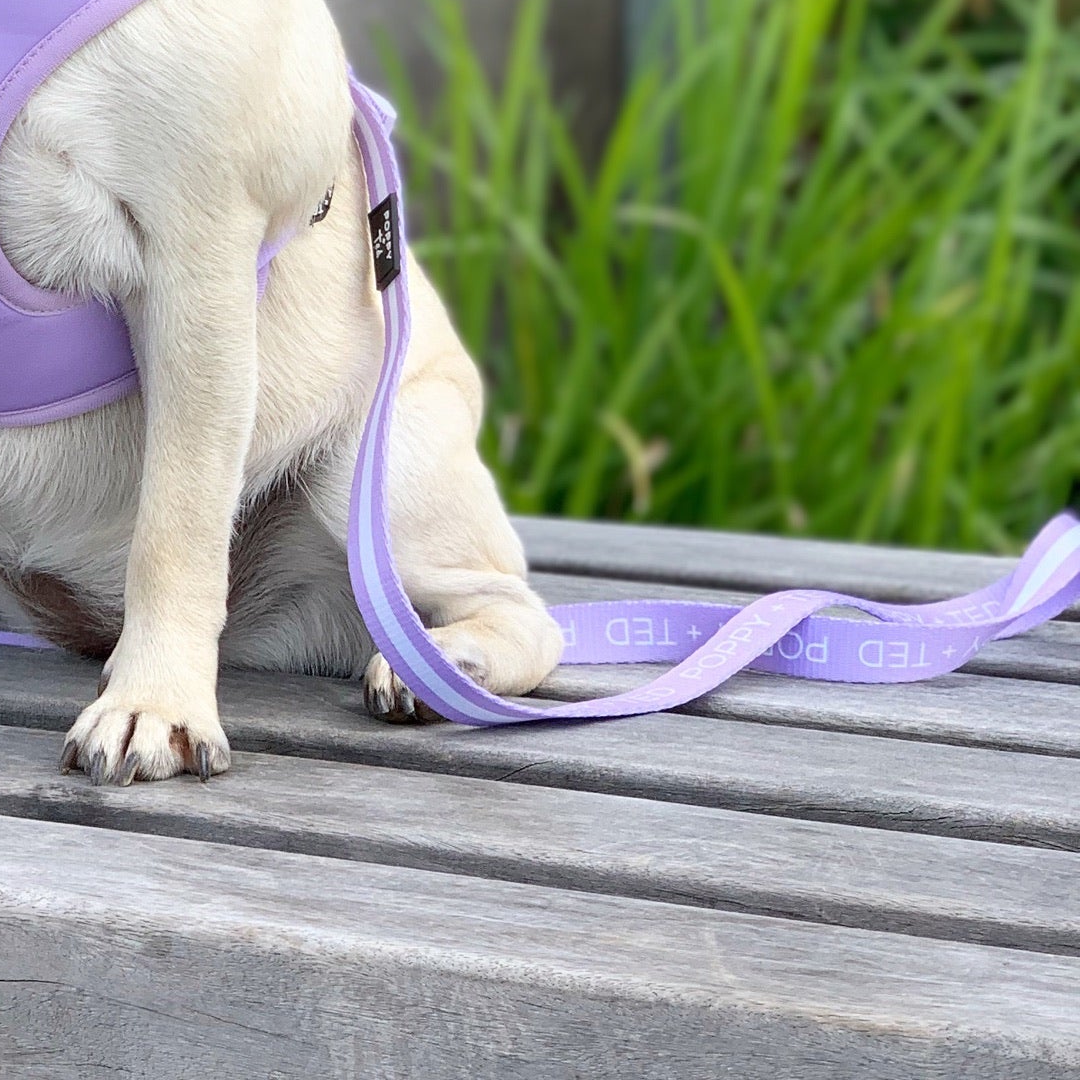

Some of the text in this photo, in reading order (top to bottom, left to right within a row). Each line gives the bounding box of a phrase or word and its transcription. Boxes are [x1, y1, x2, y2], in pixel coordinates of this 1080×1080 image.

[605, 618, 677, 647] TED
[679, 613, 771, 680] POPPY
[858, 640, 932, 668] TED
